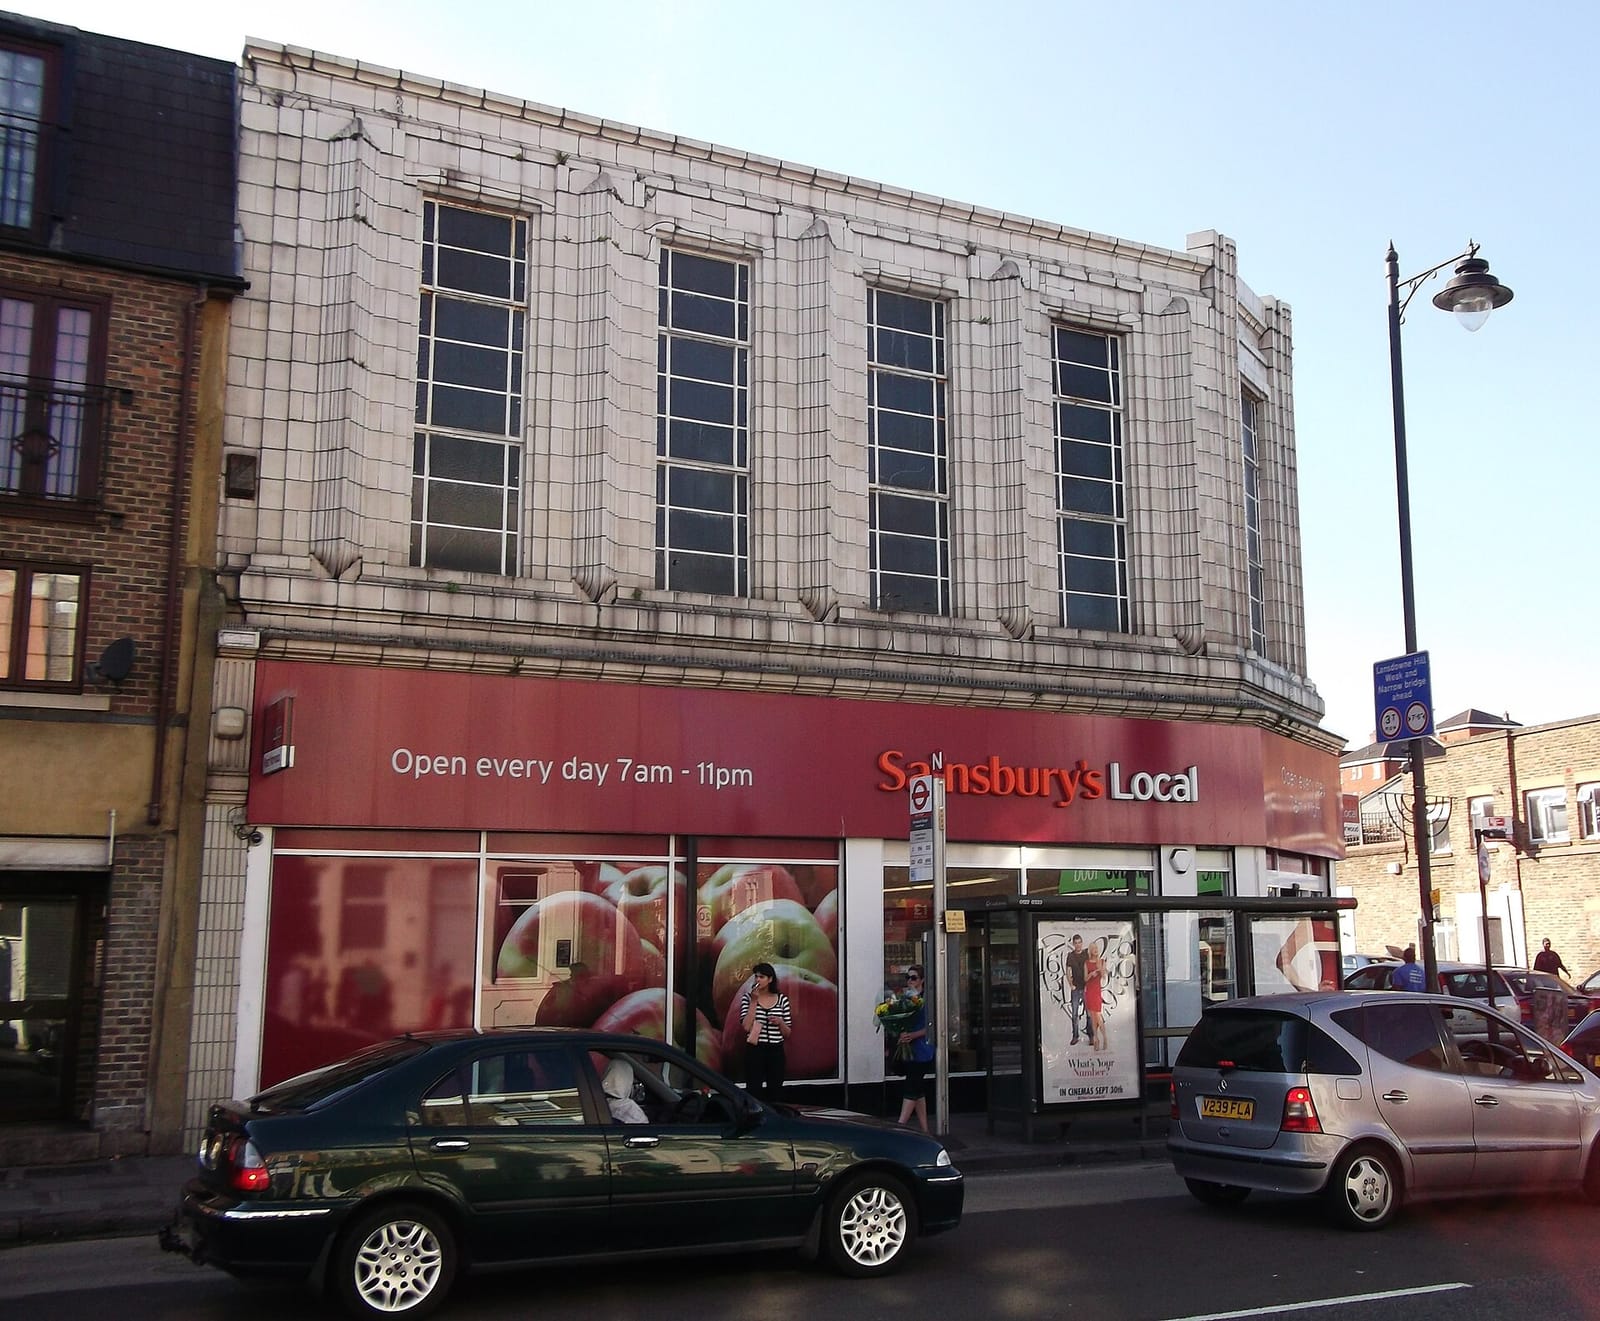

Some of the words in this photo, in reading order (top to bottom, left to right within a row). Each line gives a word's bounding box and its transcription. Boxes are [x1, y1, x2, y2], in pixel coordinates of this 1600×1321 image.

[1375, 660, 1412, 675] Lansdowne
[1413, 656, 1426, 665] Hill
[1385, 672, 1402, 682] Weak
[1404, 669, 1418, 678] and
[1378, 682, 1403, 694] Narrow
[1404, 678, 1426, 689] bridge
[1391, 690, 1413, 701] ahead
[391, 748, 467, 780] Open
[476, 756, 553, 785] every
[562, 756, 609, 787] day
[616, 758, 673, 784] 7am
[697, 761, 753, 790] 11pm
[932, 751, 943, 771] N
[877, 750, 1104, 808] Sansbury's
[1109, 761, 1200, 803] Local
[1068, 1057, 1095, 1068] What's
[1096, 1058, 1115, 1068] Your
[1059, 1087, 1067, 1097] IN
[1068, 1086, 1094, 1096] CINEMAS
[1095, 1085, 1109, 1095] SEPT
[1110, 1084, 1124, 1094] 30th
[1203, 1099, 1229, 1113] V239
[1230, 1102, 1251, 1116] FLA
